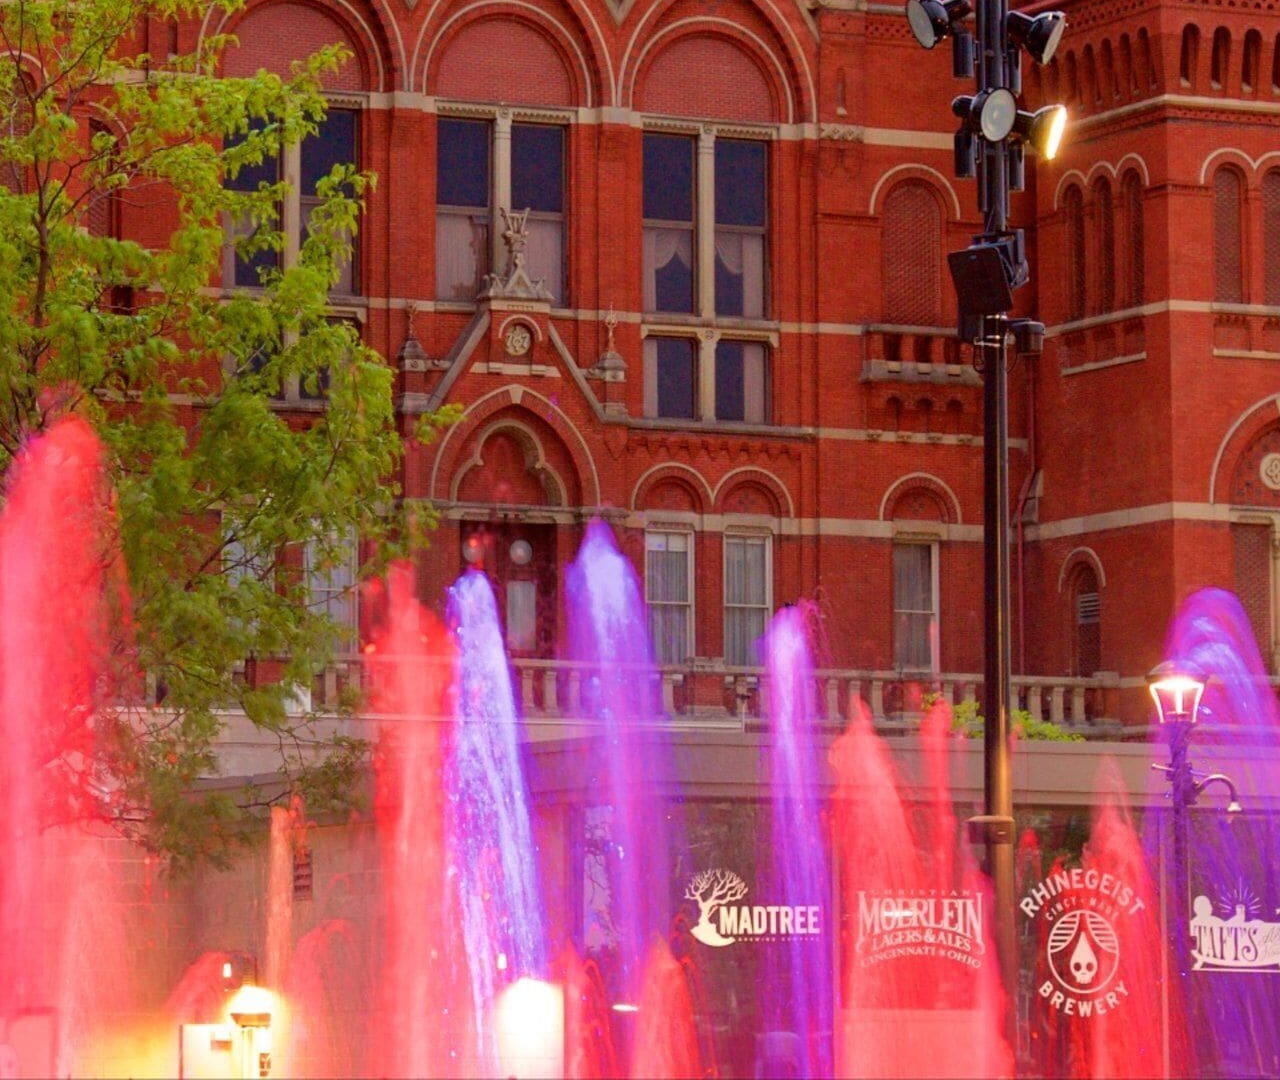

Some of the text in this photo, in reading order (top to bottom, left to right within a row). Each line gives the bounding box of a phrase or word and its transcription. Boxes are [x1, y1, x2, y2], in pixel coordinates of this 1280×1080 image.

[1020, 868, 1146, 918] RHINEGEIST
[719, 905, 820, 935] MADTREE
[855, 890, 986, 955] MOERLEIN
[872, 929, 922, 951] LAGERS
[937, 932, 972, 952] ALES
[947, 950, 982, 968] OHIO
[1038, 980, 1129, 1018] BREWERY
